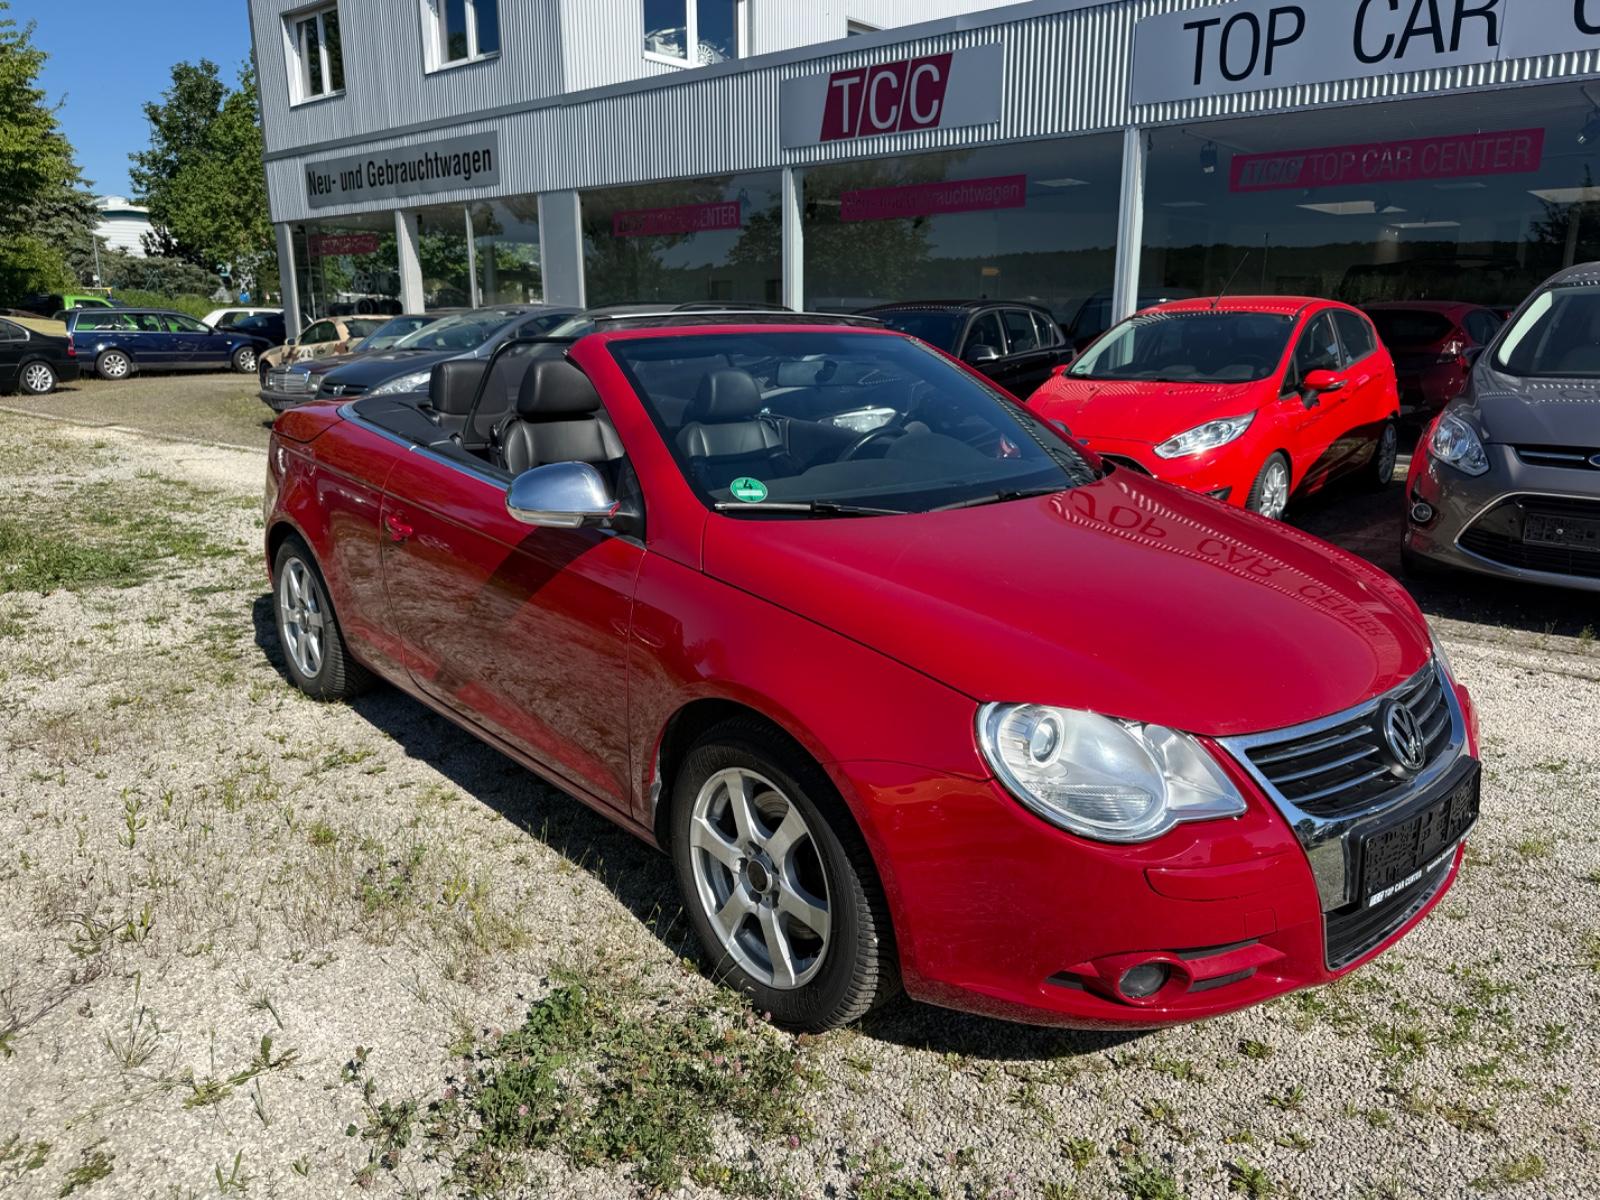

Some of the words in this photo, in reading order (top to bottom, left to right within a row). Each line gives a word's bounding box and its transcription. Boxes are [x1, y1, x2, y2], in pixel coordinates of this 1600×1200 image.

[1183, 5, 1306, 85] TOP
[1352, 0, 1499, 64] CAR
[308, 170, 336, 196] Neu-
[340, 163, 363, 192] und
[367, 148, 492, 188] Gebrauchtwagen
[1310, 152, 1354, 182] TOP
[1361, 147, 1414, 178] CAR
[1421, 135, 1532, 174] CENTER
